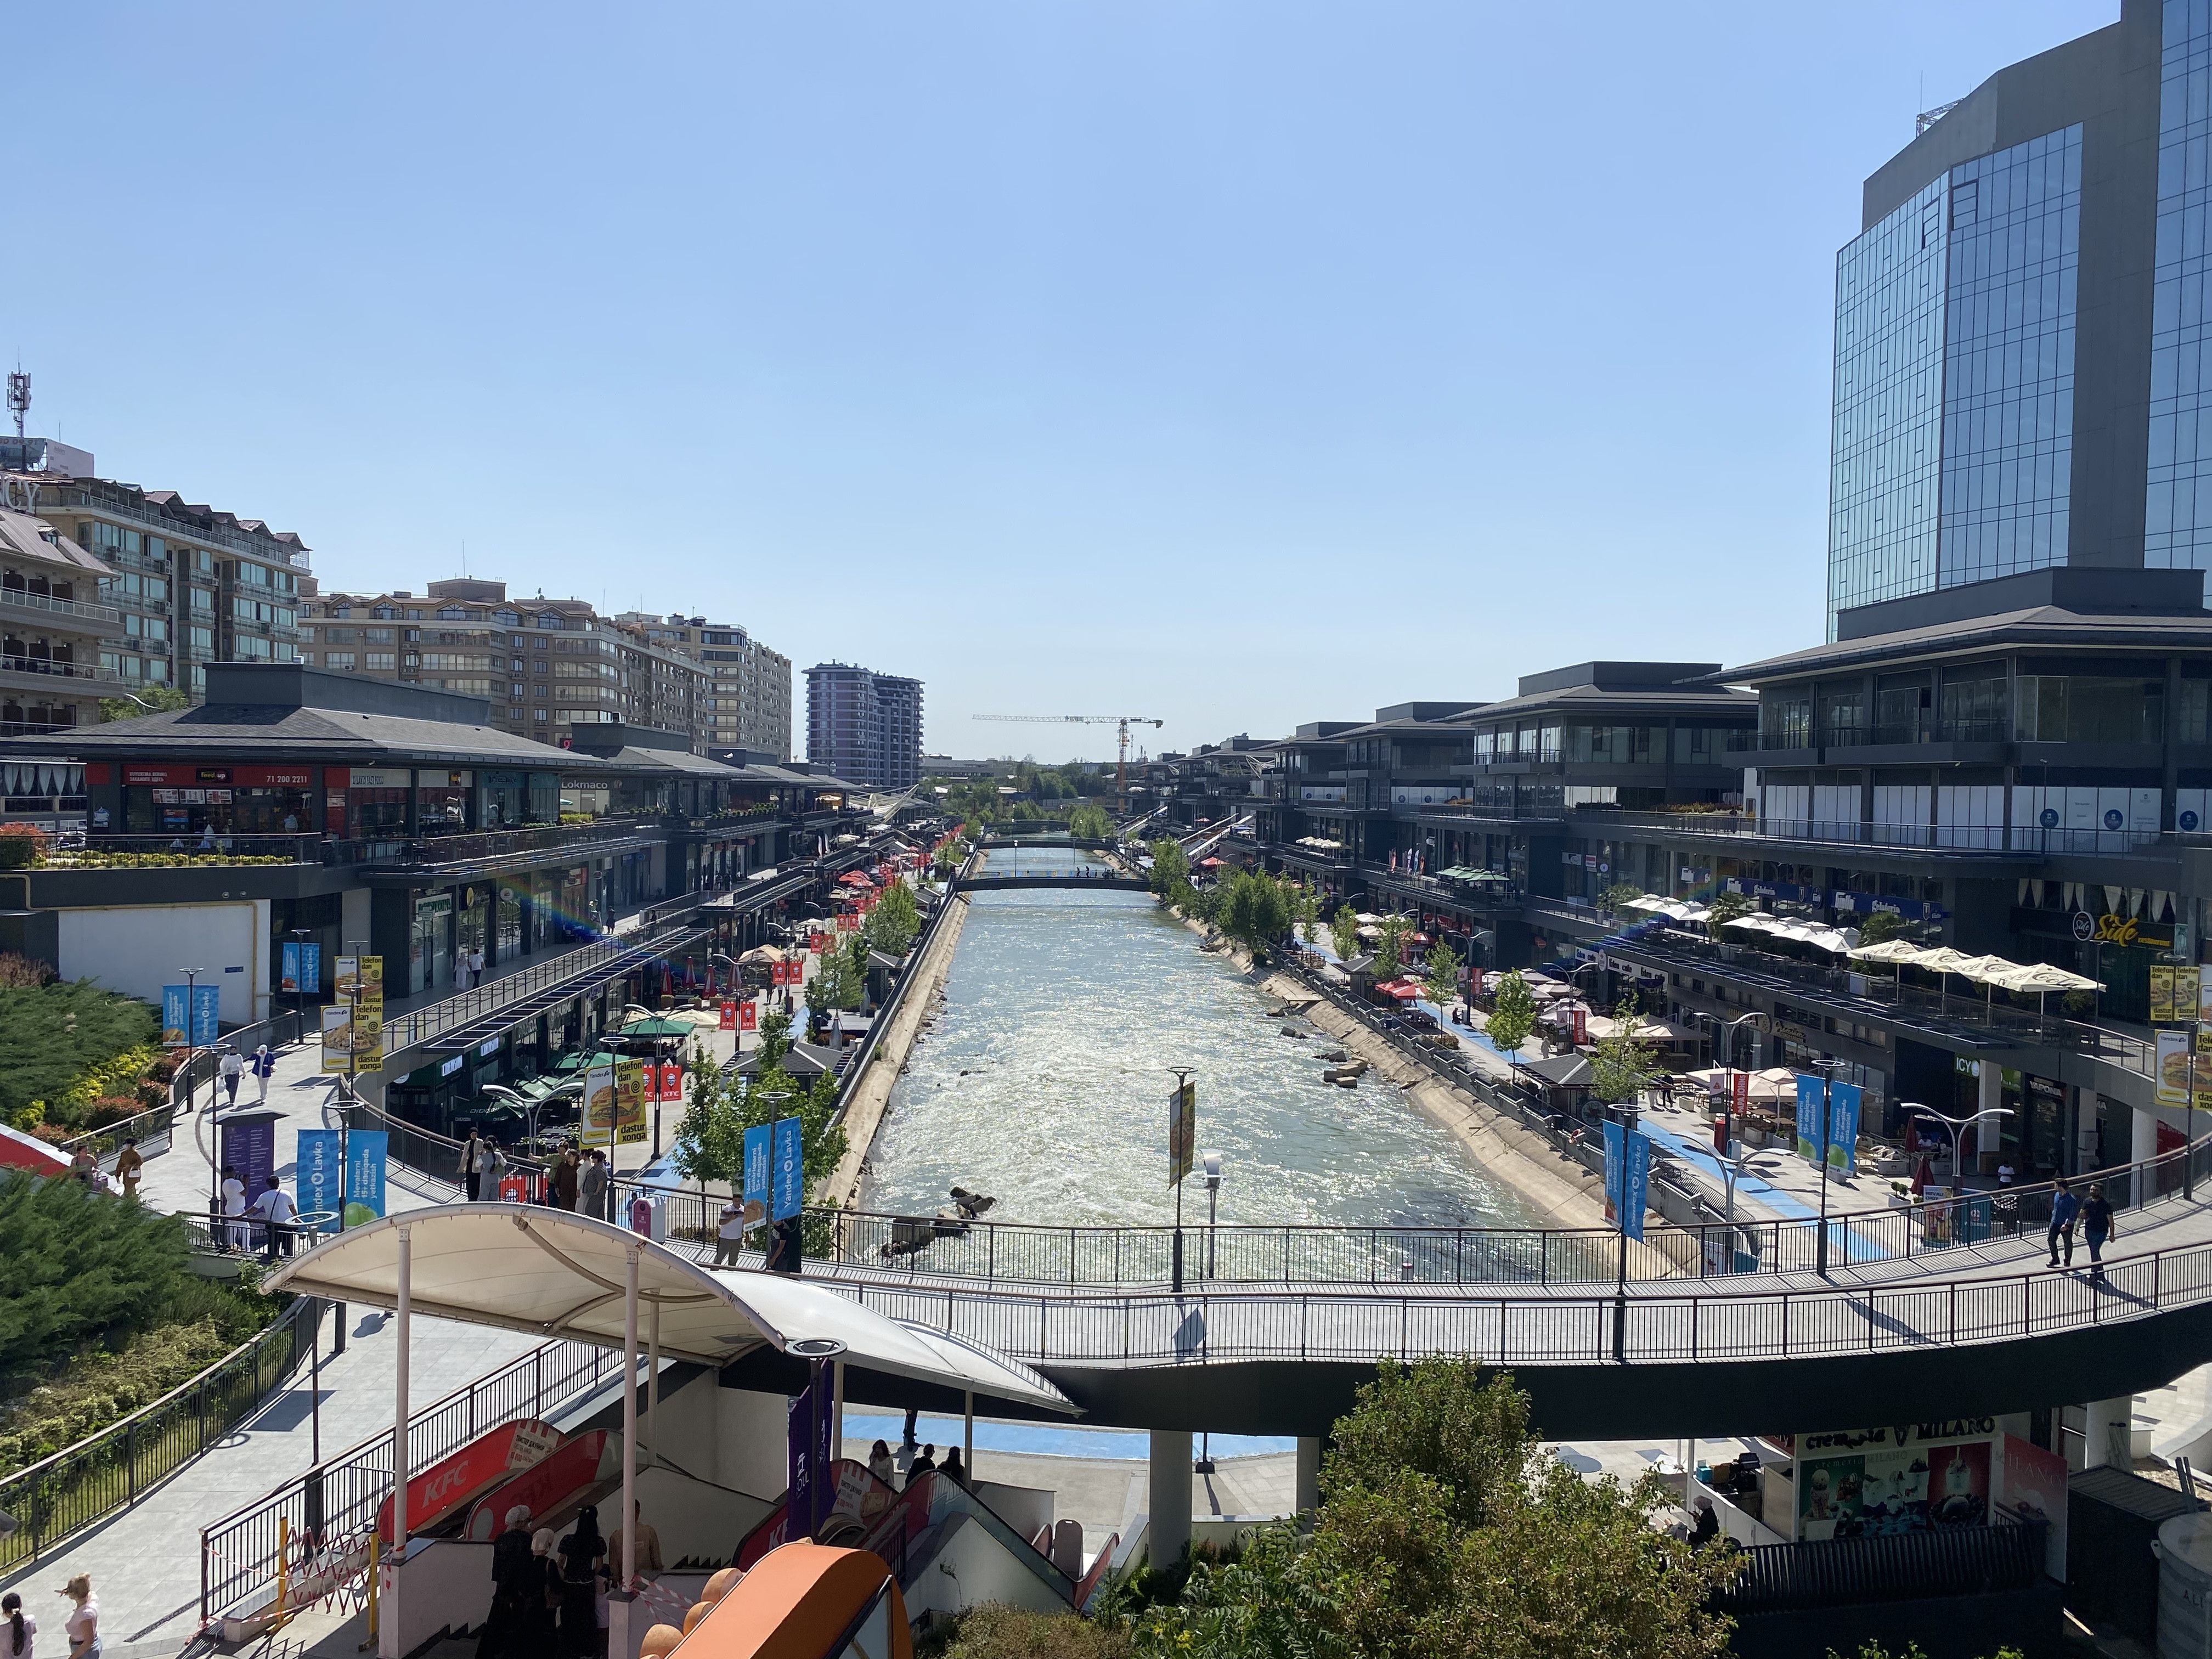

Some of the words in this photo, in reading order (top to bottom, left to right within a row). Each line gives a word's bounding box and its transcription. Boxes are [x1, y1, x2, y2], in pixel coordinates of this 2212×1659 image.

[561, 779, 608, 789] Lokmaco
[2074, 919, 2090, 933] Side
[2094, 914, 2140, 947] Side
[1621, 964, 1633, 973] cafe
[356, 1005, 382, 1013] Telefon
[617, 1062, 642, 1073] Telefon
[1956, 1057, 1971, 1071] ICY
[618, 1073, 631, 1082] dan
[2029, 1080, 2063, 1097] YAPONA
[621, 1124, 646, 1134] dastur
[622, 1132, 646, 1142] xonga
[313, 1141, 323, 1171] Lavka
[1633, 1144, 1641, 1175] Lavka
[747, 1167, 751, 1177] va
[369, 1163, 377, 1199] yetkazish
[784, 1173, 792, 1209] Yandex
[1916, 1417, 1996, 1441] MILANO
[1815, 1459, 1864, 1469] cremeria
[1865, 1450, 1908, 1464] MILANO
[421, 1459, 469, 1509] KFC
[769, 1518, 789, 1551] KF
